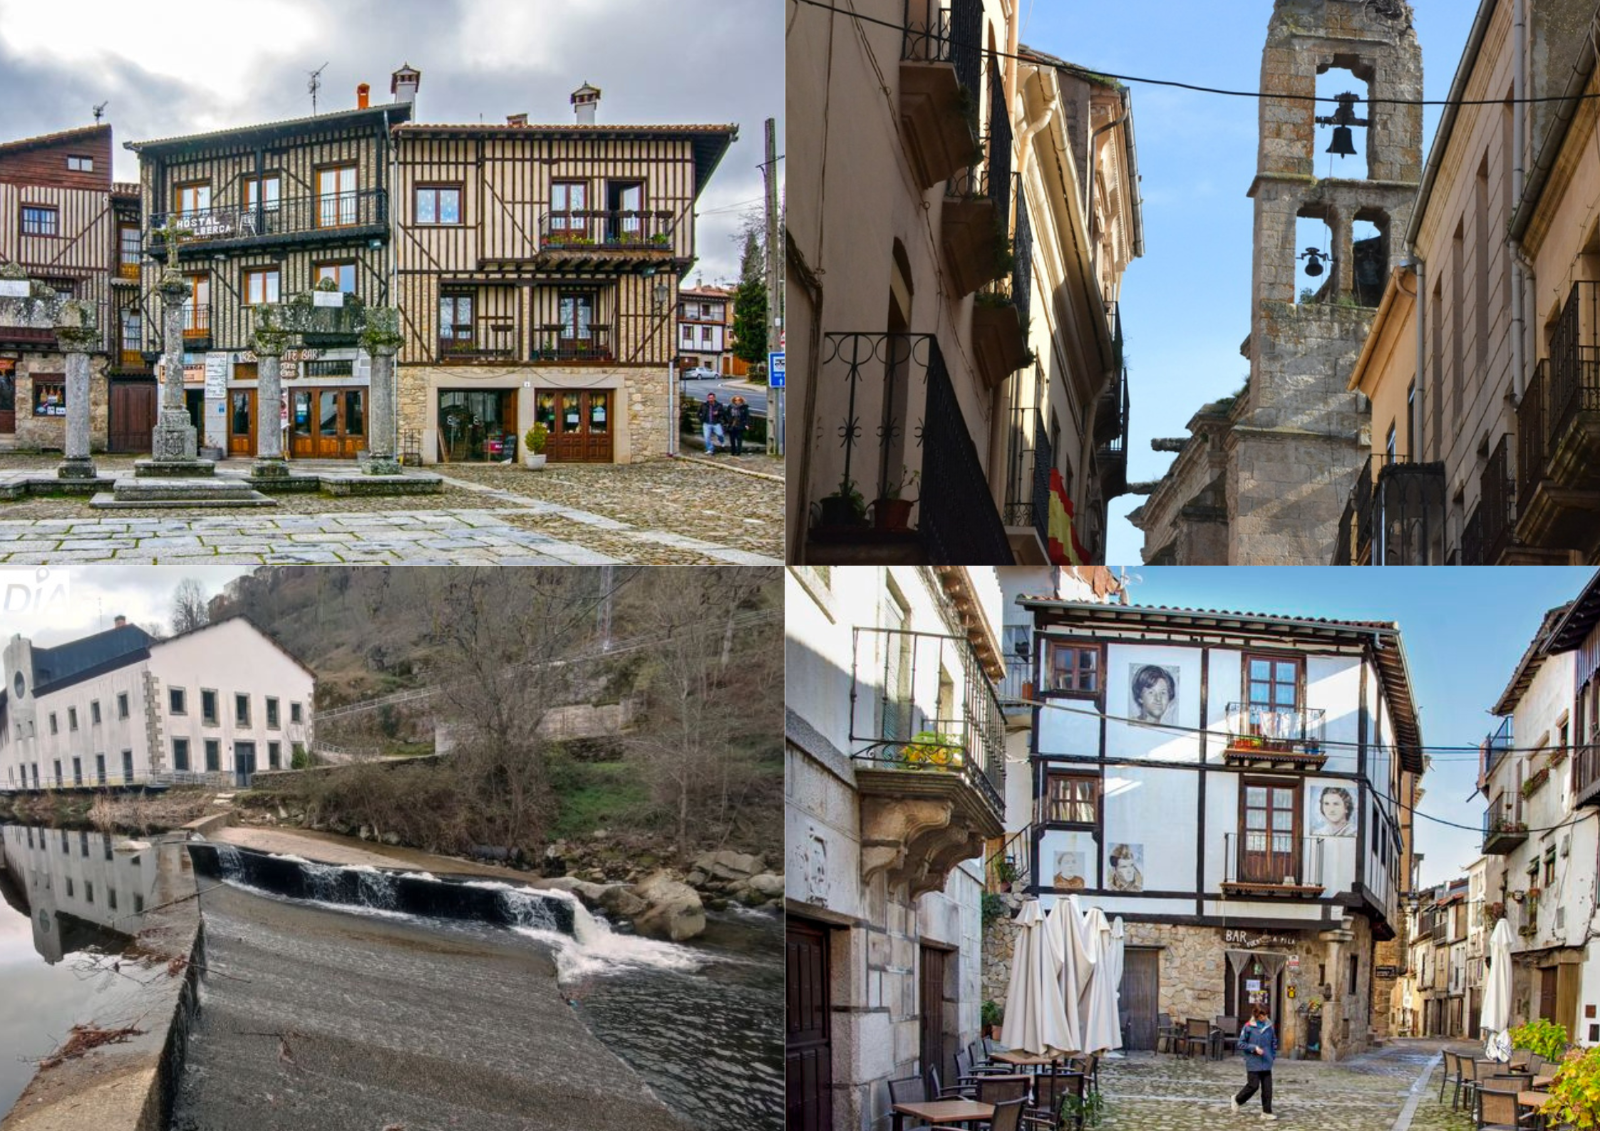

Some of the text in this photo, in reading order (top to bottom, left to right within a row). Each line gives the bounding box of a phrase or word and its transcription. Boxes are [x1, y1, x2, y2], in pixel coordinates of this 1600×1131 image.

[176, 216, 219, 230] HOSTAL
[192, 225, 231, 235] LBERCA
[302, 348, 318, 360] BAR
[1225, 929, 1247, 943] BAR
